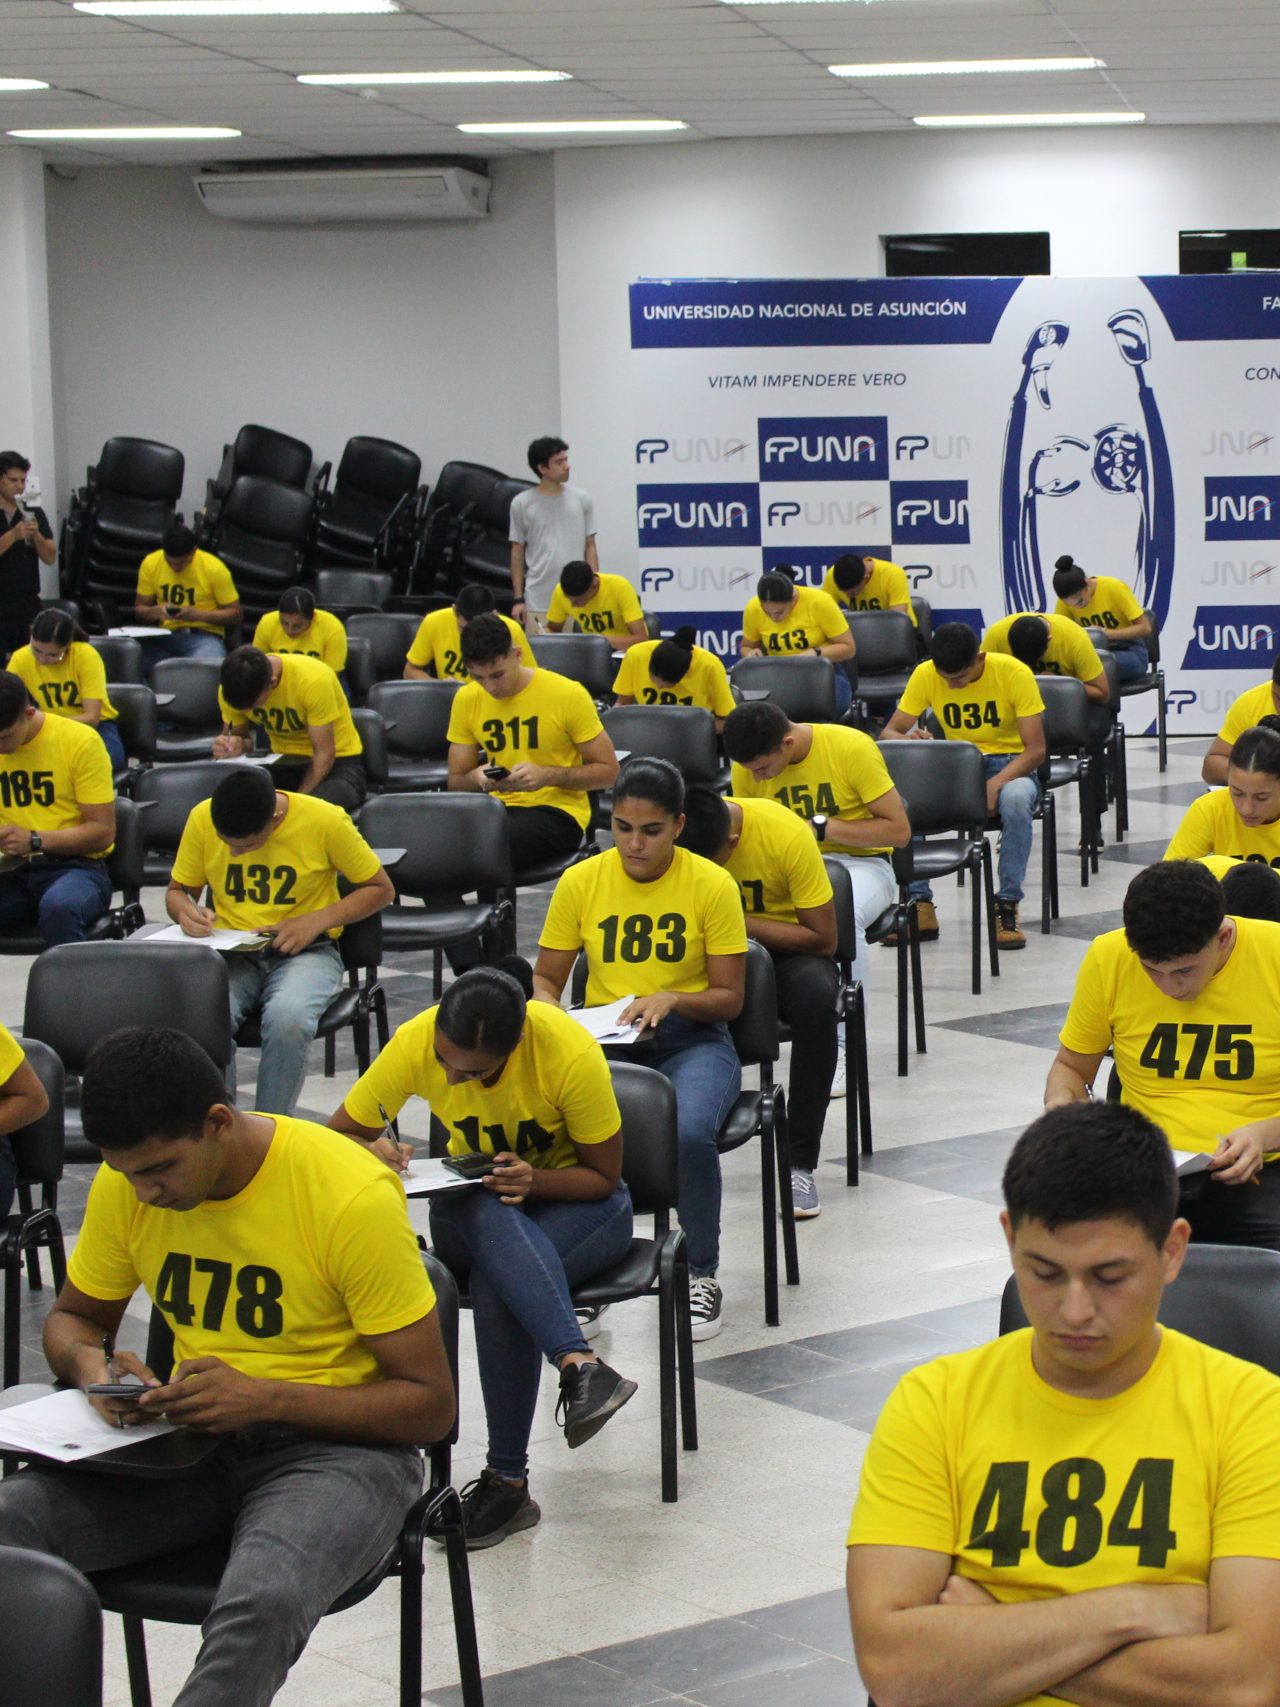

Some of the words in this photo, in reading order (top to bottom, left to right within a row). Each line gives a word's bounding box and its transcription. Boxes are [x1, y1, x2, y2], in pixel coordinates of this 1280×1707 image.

[643, 305, 754, 320] UNIVERSIDAD
[759, 303, 846, 318] NACIONAL
[851, 302, 873, 316] DE
[877, 298, 967, 316] ASUNCIÓN
[708, 375, 757, 389] VITAM
[762, 373, 857, 388] IMPENDERE
[863, 372, 907, 387] VERO
[160, 583, 195, 606] 161
[578, 611, 614, 633] 267
[768, 629, 809, 652] 413
[38, 681, 79, 708] 172
[943, 700, 1001, 730] 034
[482, 716, 539, 752] 311
[0, 770, 55, 808] 185
[774, 782, 840, 820] 154
[225, 864, 297, 905] 432
[598, 912, 686, 964] 183
[1139, 1022, 1255, 1081] 475
[453, 1115, 555, 1156] 114
[156, 1251, 284, 1339] 478
[963, 1457, 1177, 1568] 484
